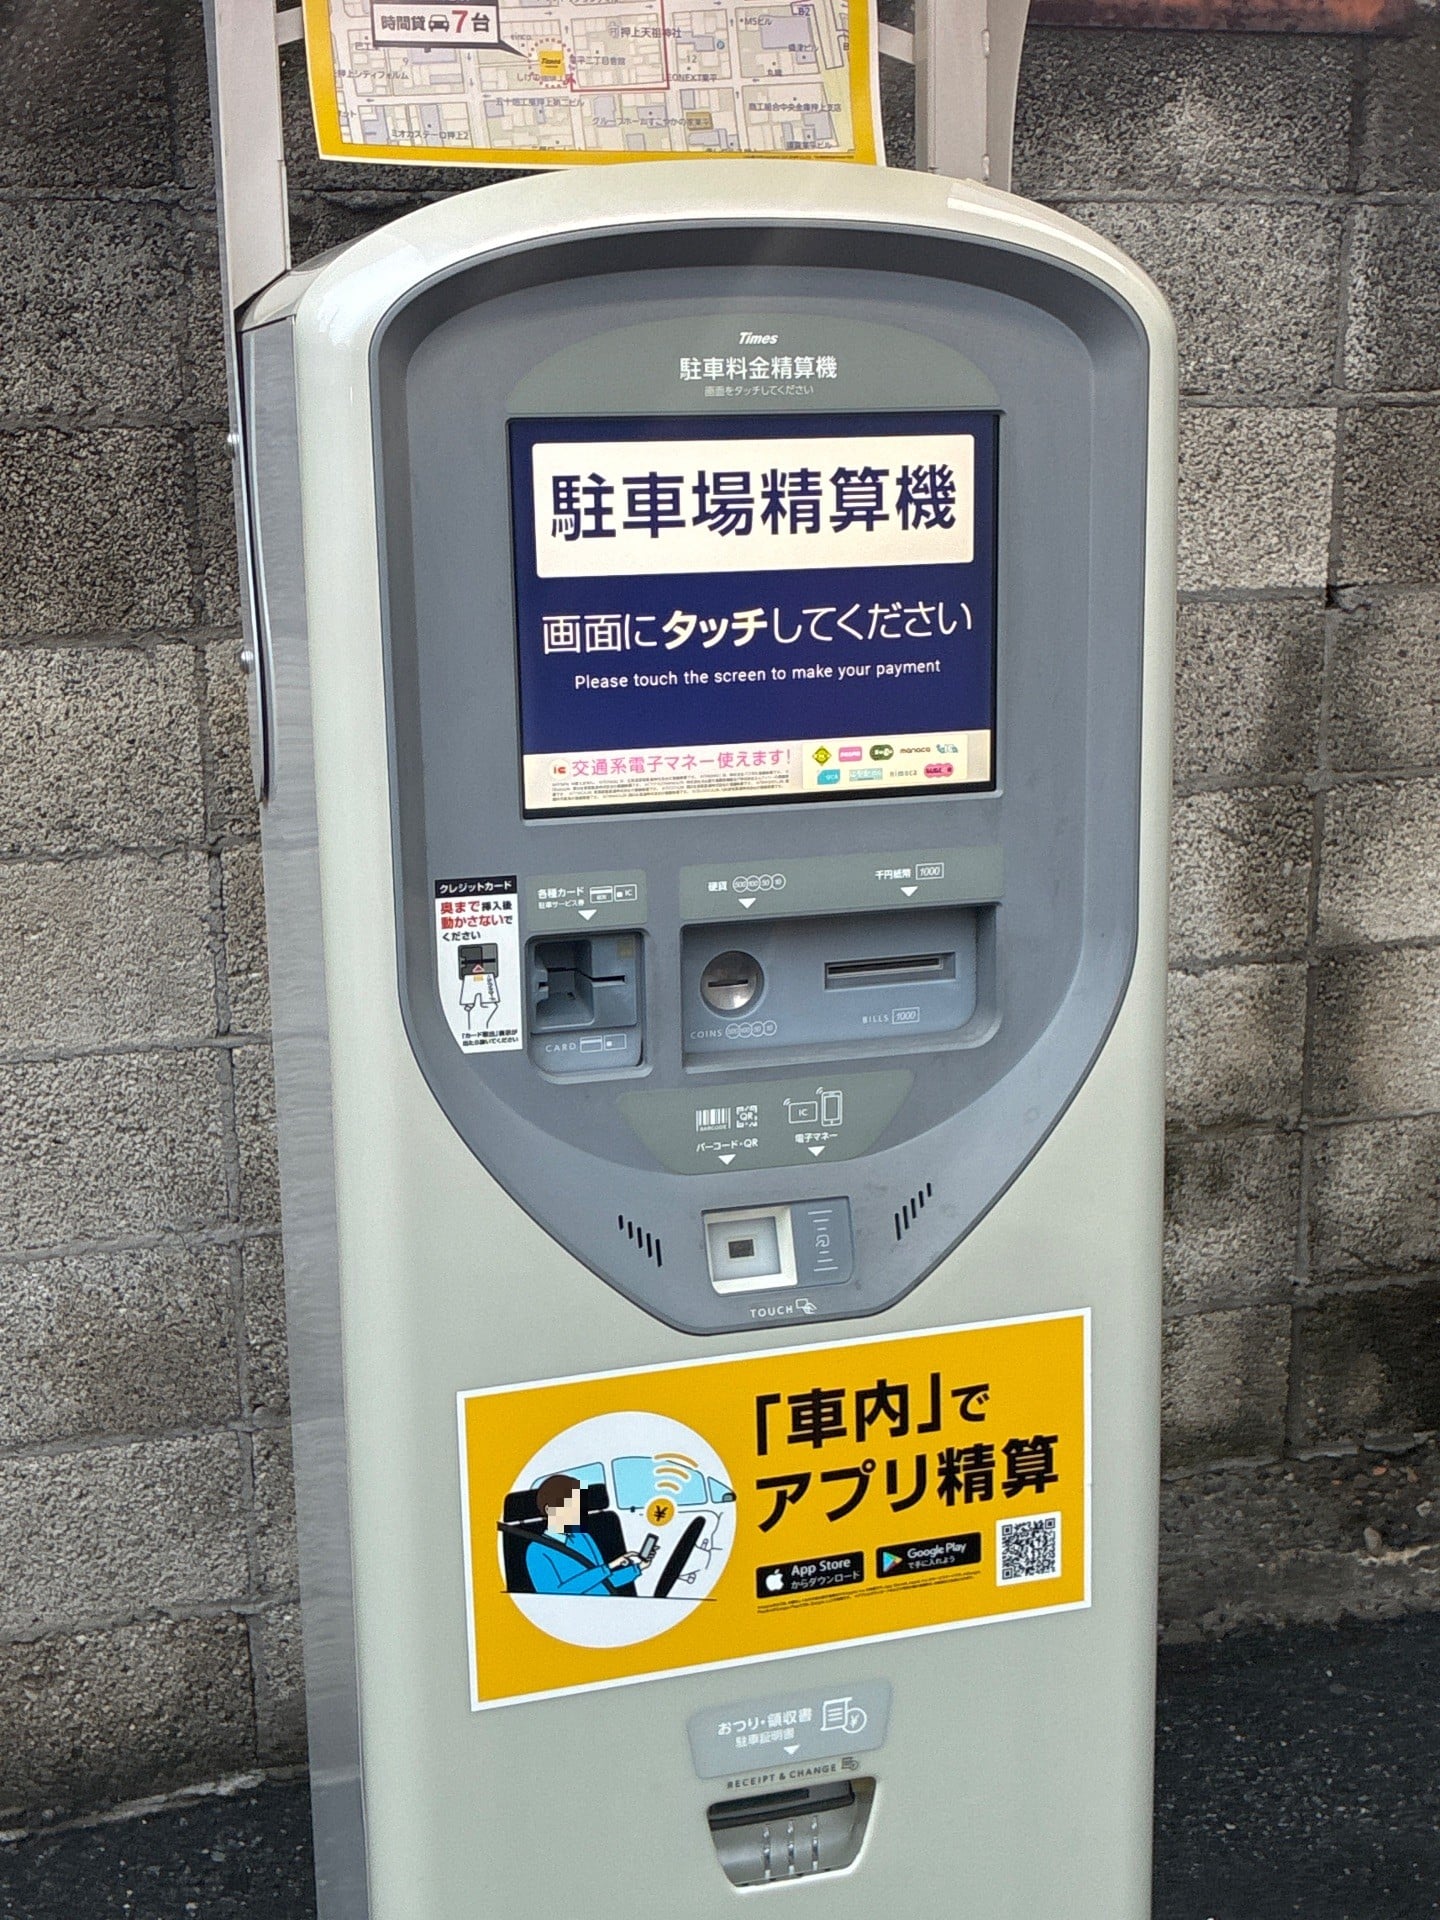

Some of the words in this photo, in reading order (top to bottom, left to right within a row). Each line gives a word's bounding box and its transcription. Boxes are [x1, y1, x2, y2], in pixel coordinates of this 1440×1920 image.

[381, 15, 426, 31] 時間貸
[452, 10, 468, 33] 7
[471, 12, 490, 32] 台
[738, 331, 779, 345] Times
[679, 355, 838, 381] 駐車料金精算機
[704, 385, 814, 397] 画面をタッチしてください
[551, 463, 957, 542] 駐車場精算機
[542, 601, 973, 655] 画面にタッチしてください
[574, 673, 628, 690] Please
[634, 670, 678, 687] touch
[684, 669, 709, 685] the
[714, 669, 766, 683] screen
[771, 666, 786, 681] to
[792, 663, 834, 679] make
[838, 664, 871, 680] your
[875, 658, 941, 677] payment
[571, 748, 791, 777] 交通系電子マネー使えます!
[875, 868, 911, 880] 千円紙幣
[920, 867, 940, 876] 1000
[439, 881, 513, 894] クレジットカード
[537, 886, 584, 899] 各種カード
[708, 881, 728, 892] 硬貨
[440, 901, 512, 914] 奥まで挿入後
[441, 915, 513, 929] 動かさないで
[442, 932, 481, 942] ください
[862, 1013, 889, 1024] BILLS
[894, 1010, 917, 1022] 1000
[690, 1029, 722, 1039] COINS
[545, 1042, 577, 1053] CARD
[740, 1112, 753, 1121] QR
[798, 1108, 809, 1117] IC
[795, 1131, 838, 1143] 電子マネー
[696, 1138, 758, 1152] バーコード・QR
[750, 1305, 793, 1318] TOUCH
[756, 1372, 989, 1456] 「車内」で
[756, 1435, 1059, 1533] アプリ精算
[907, 1546, 944, 1561] Google
[945, 1542, 966, 1558] Play
[791, 1562, 816, 1578] App
[818, 1557, 851, 1571] Store
[908, 1555, 956, 1569] で手に入れよう
[791, 1570, 861, 1590] からダウンロード
[717, 1707, 813, 1736] おつり・領収書
[735, 1728, 795, 1748] 駐車証明書
[727, 1773, 775, 1789] RECEIPT
[779, 1772, 785, 1780] &
[789, 1764, 837, 1779] CHANGE
